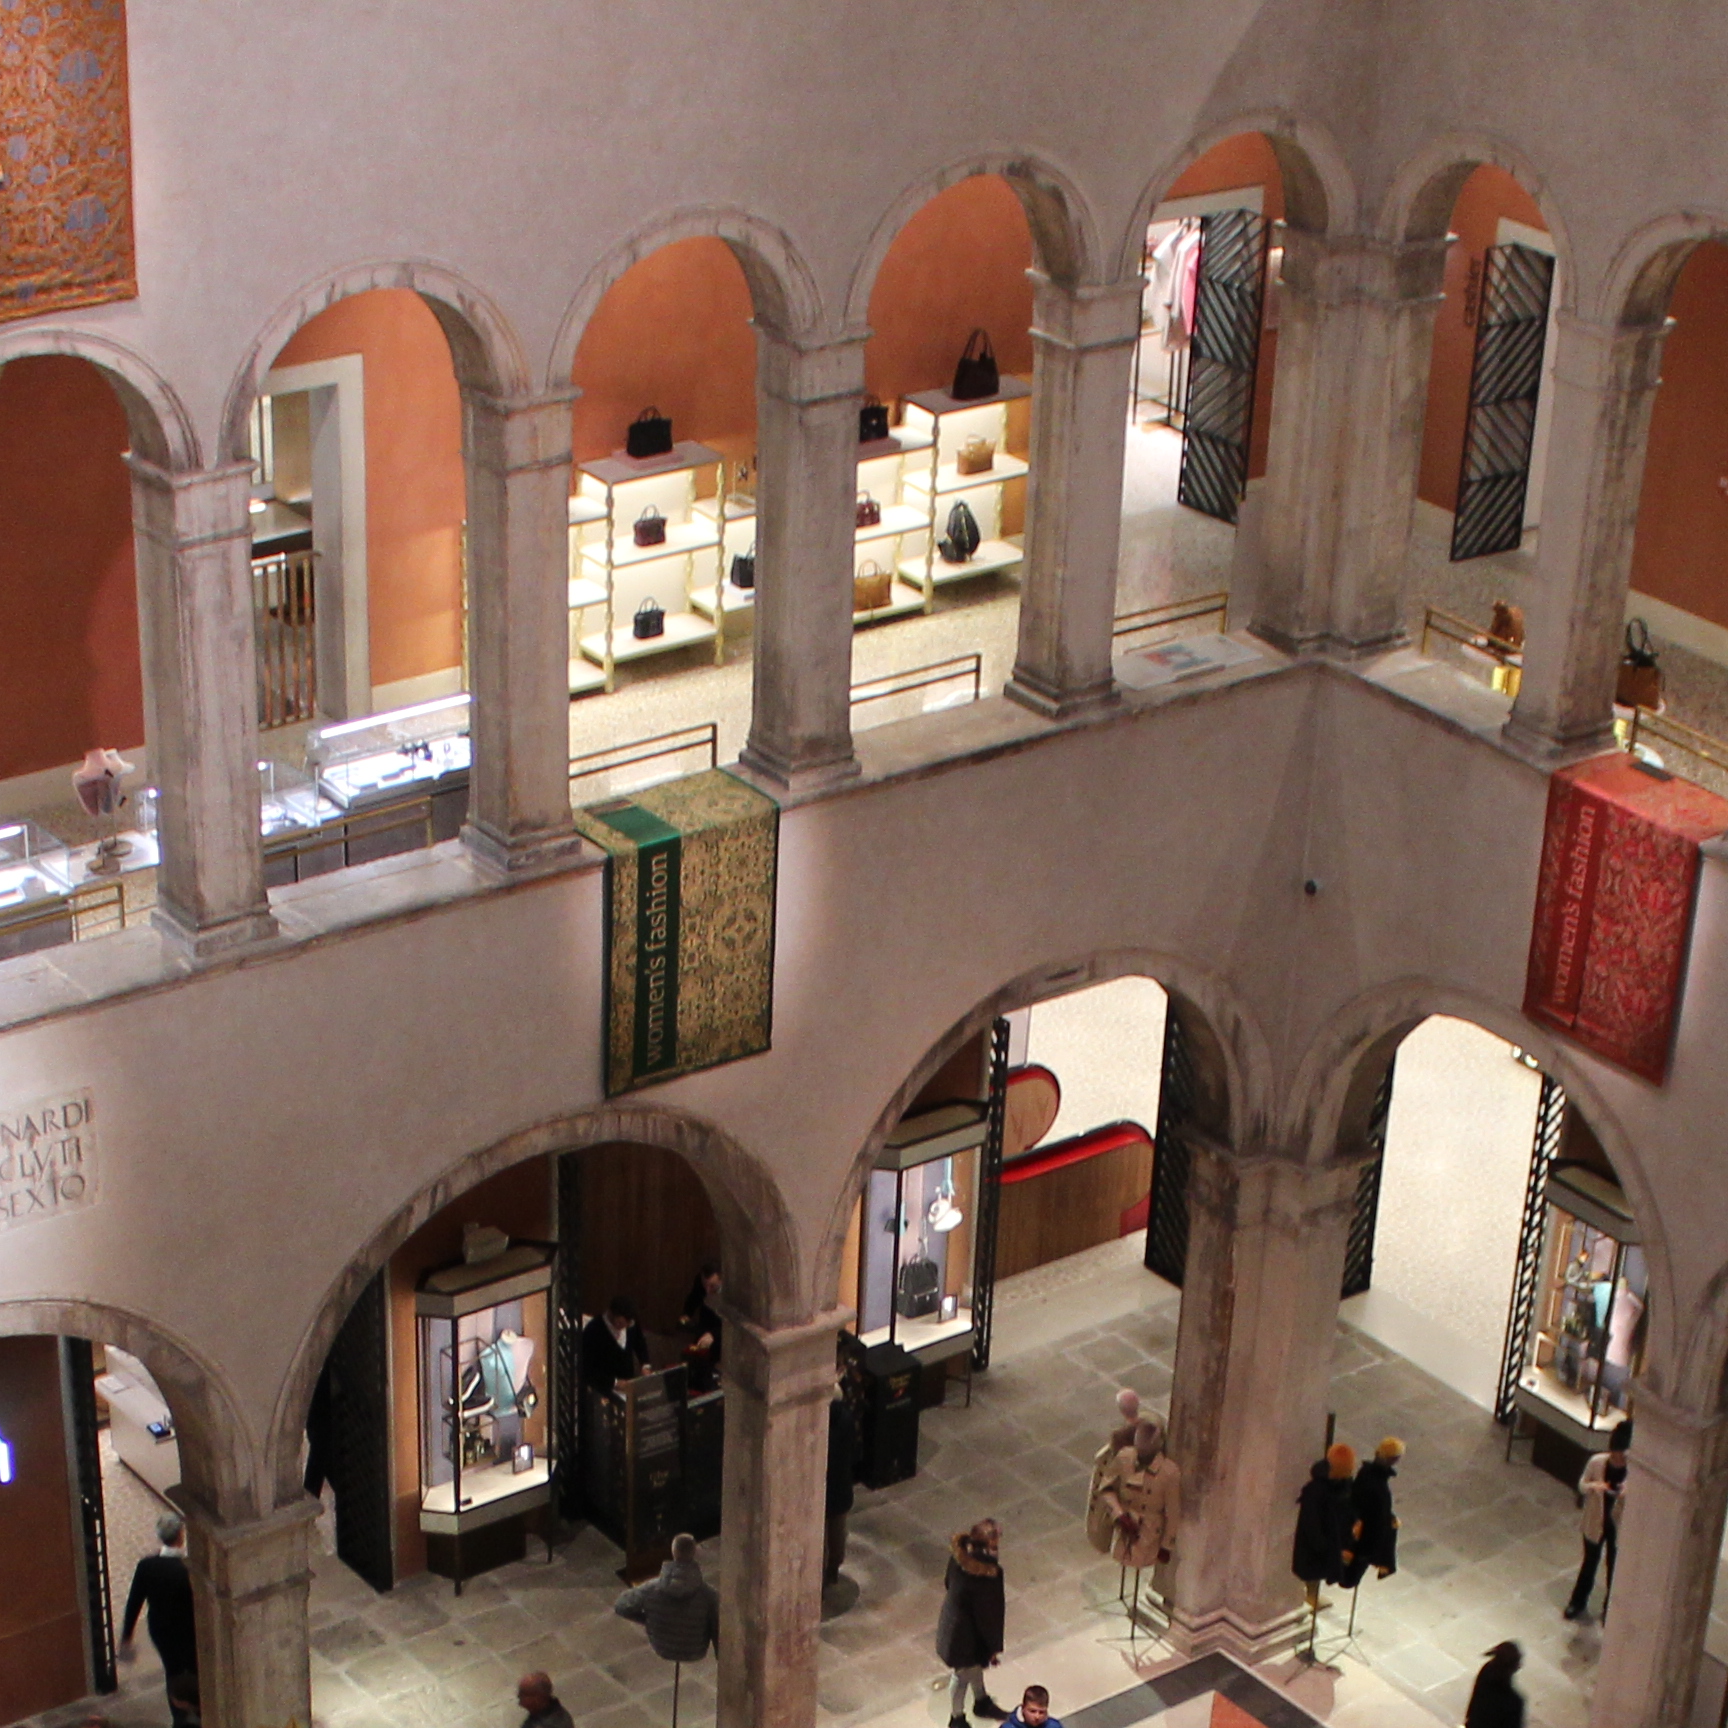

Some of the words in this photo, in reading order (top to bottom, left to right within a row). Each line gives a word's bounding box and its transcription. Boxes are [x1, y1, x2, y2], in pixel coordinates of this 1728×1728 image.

[644, 851, 670, 953] fashion
[1564, 805, 1596, 898] fashion
[1552, 900, 1581, 1004] women's
[644, 957, 666, 1066] women's
